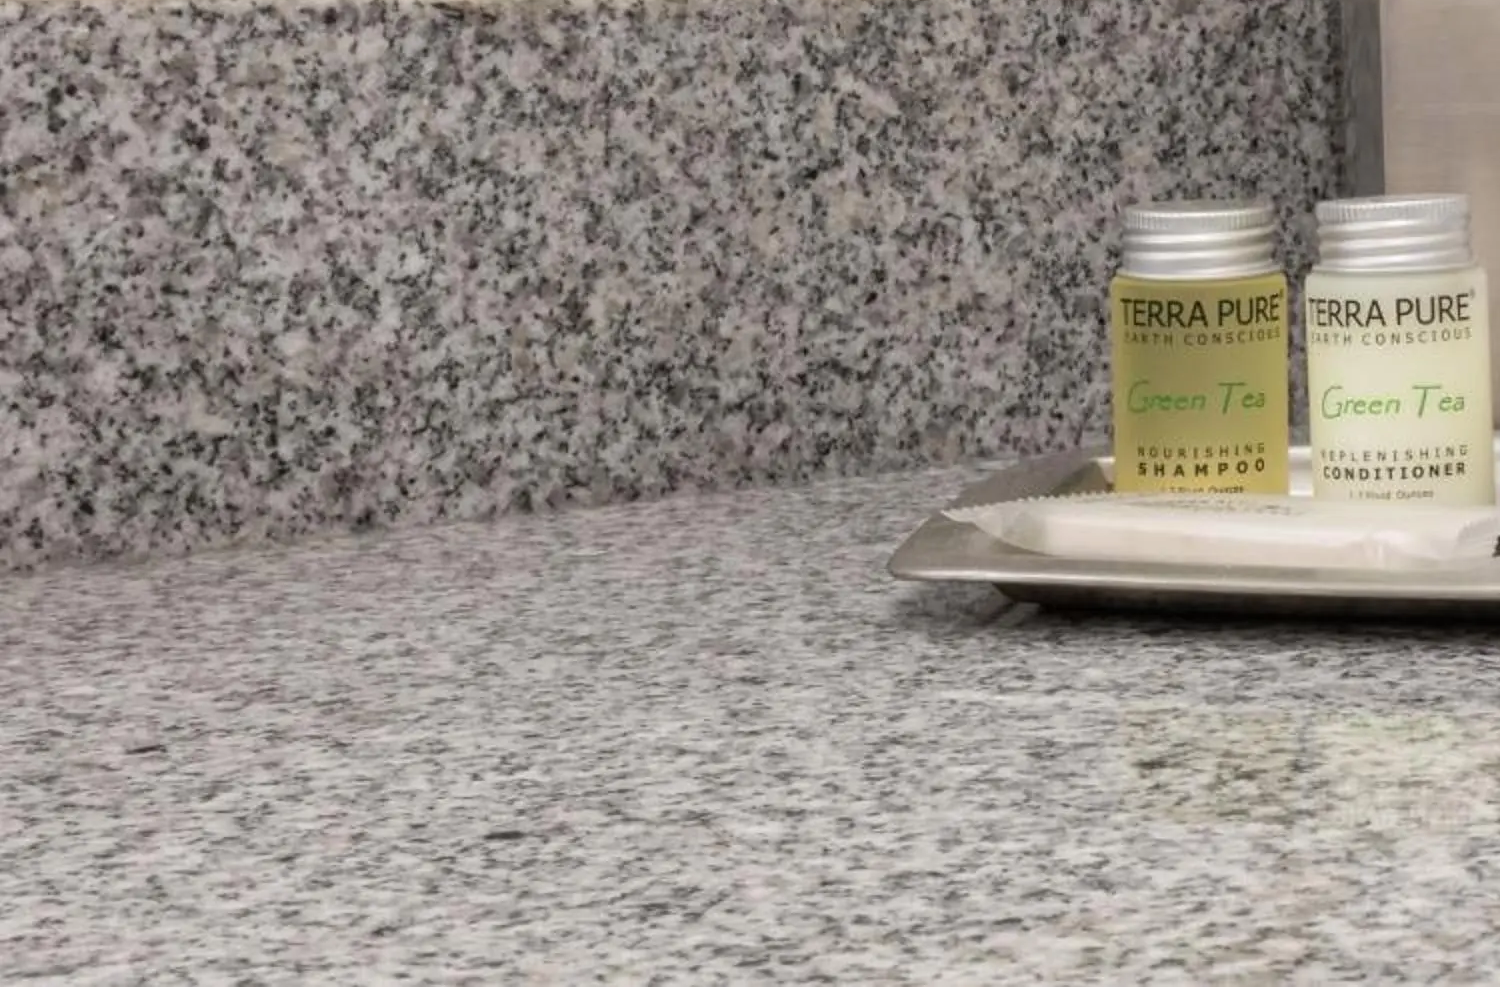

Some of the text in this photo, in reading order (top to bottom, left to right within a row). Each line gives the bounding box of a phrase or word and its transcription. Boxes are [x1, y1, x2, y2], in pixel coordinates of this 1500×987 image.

[1120, 293, 1280, 328] TERRA PURE
[1308, 293, 1470, 328] TERRA PURE
[1361, 327, 1472, 346] CONSCIOUS
[1127, 379, 1266, 415] Green Tea
[1321, 384, 1465, 420] Green Tea
[1137, 441, 1265, 459] NOURISHING
[1137, 458, 1265, 478] SHAMPOO
[1323, 462, 1466, 481] CONDITIONER
